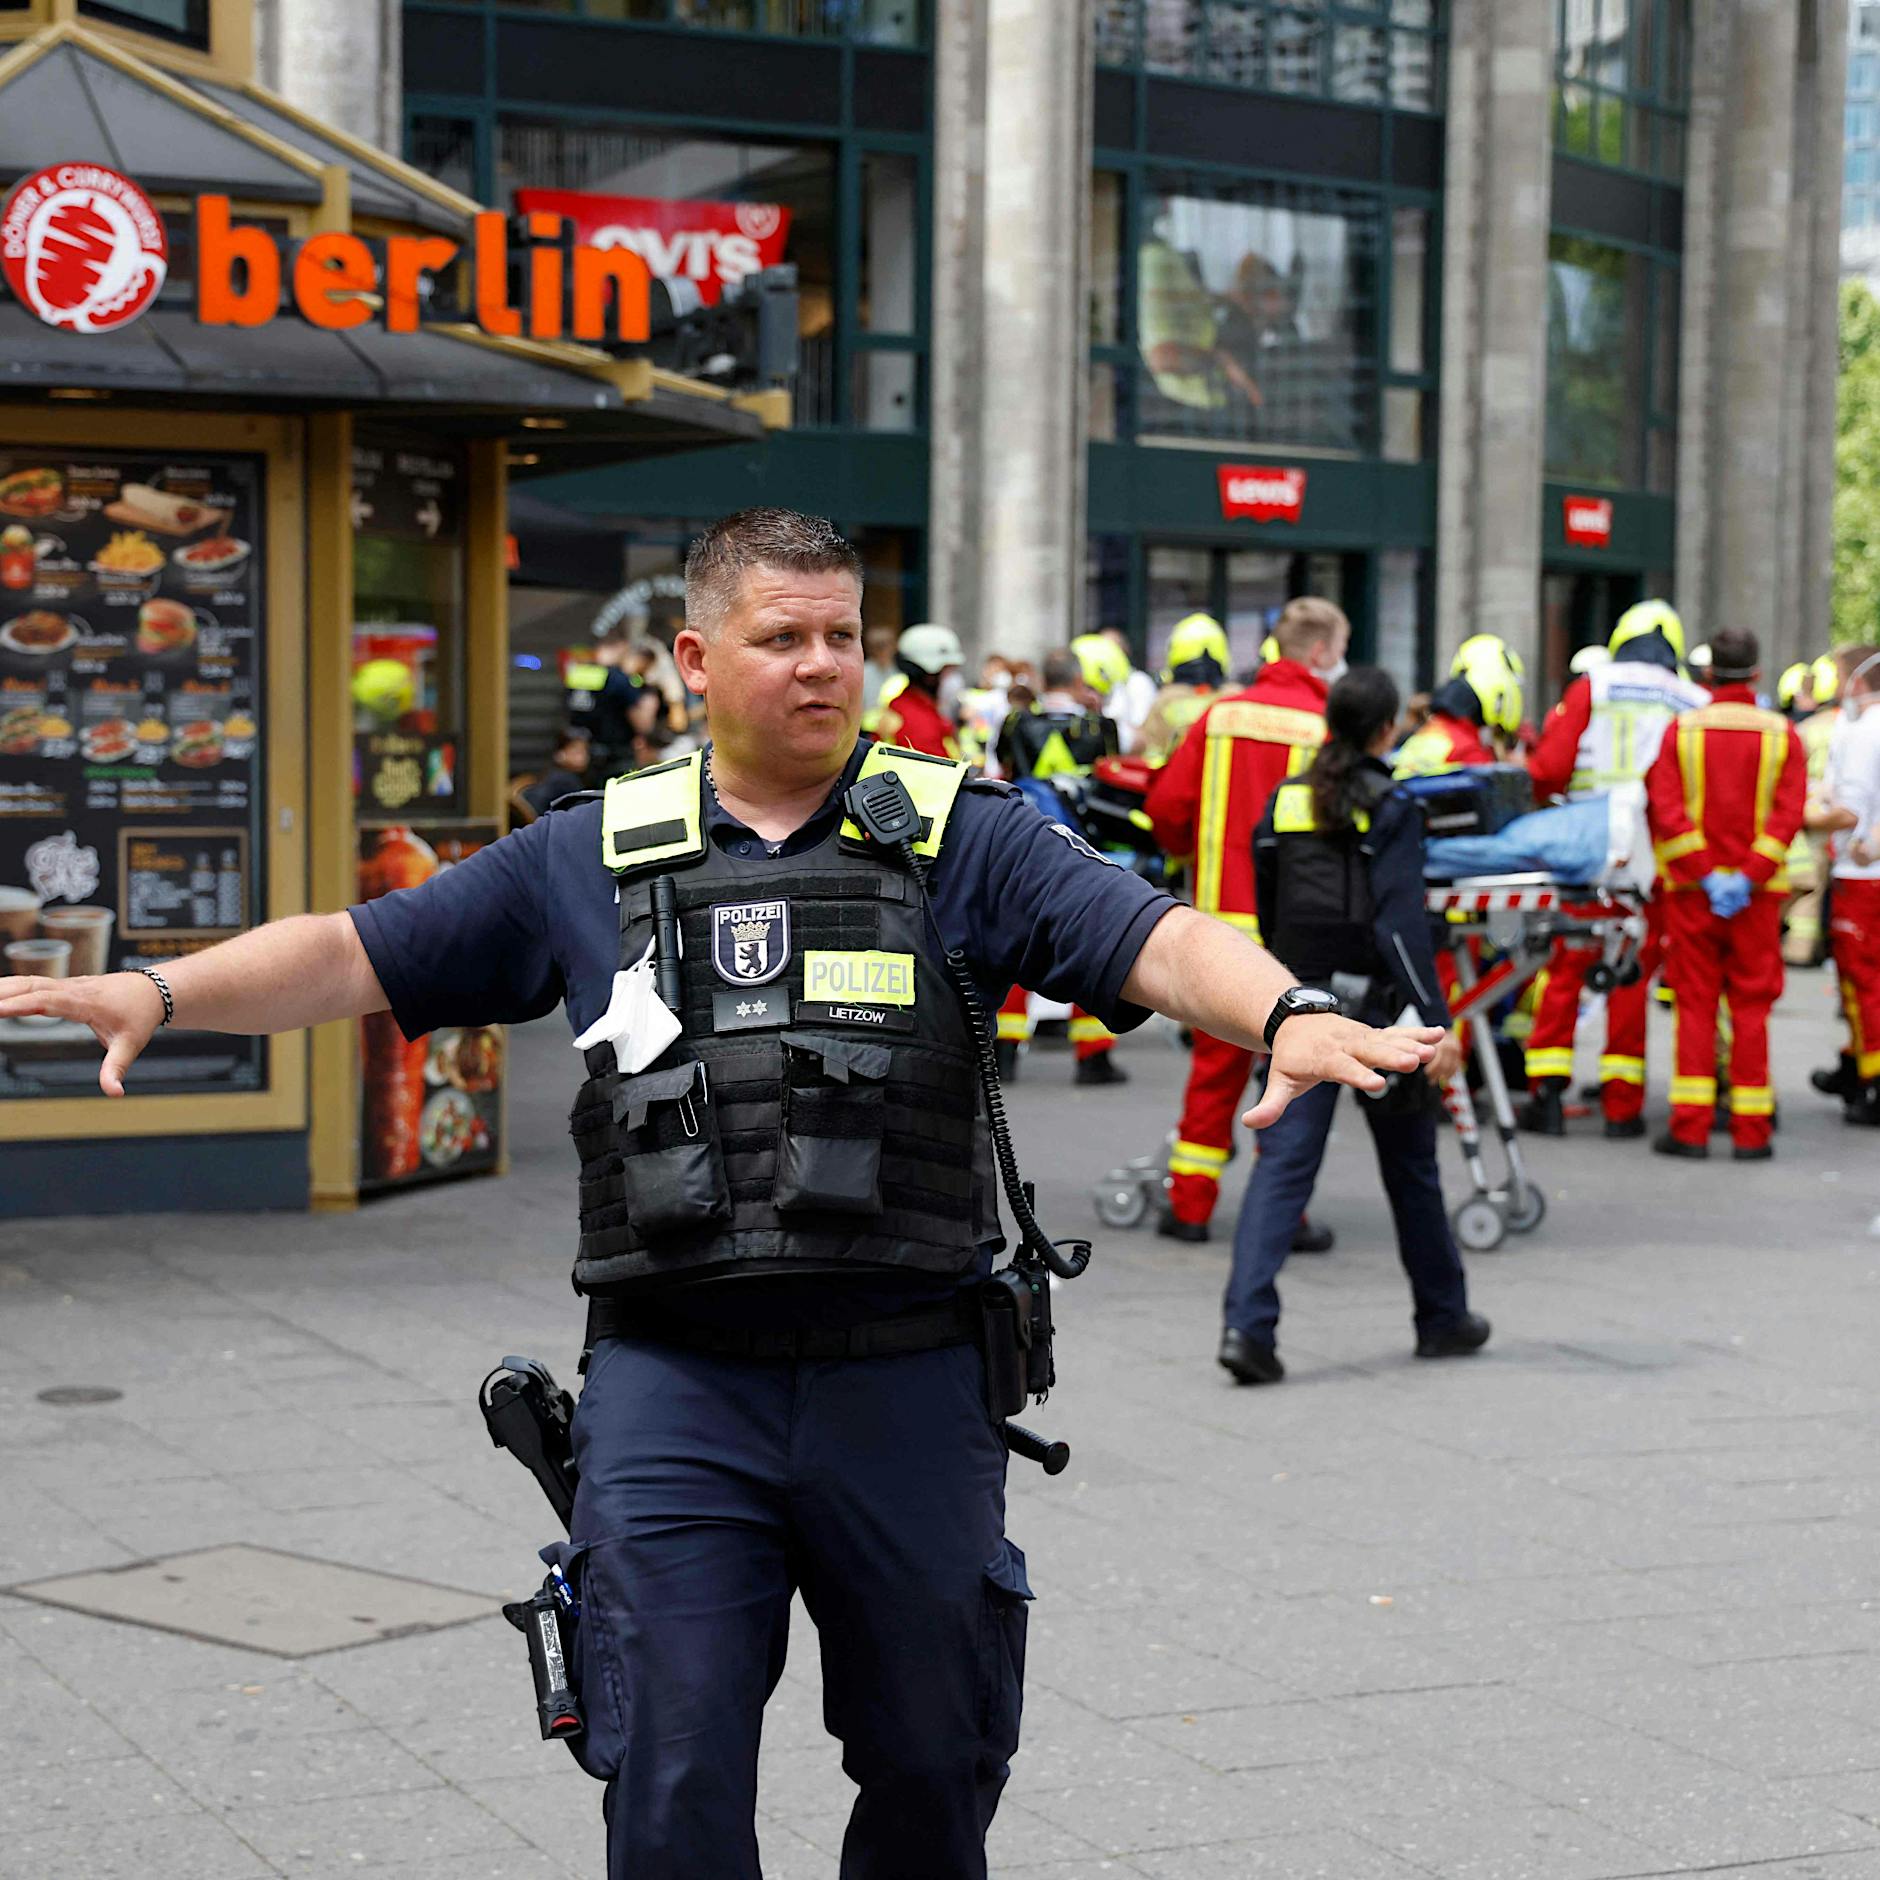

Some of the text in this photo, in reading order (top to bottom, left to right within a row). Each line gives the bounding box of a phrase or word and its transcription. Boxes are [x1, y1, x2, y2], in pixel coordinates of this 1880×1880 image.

[37, 175, 59, 197] &
[197, 194, 651, 343] berlin
[719, 904, 782, 925] POLIZEI
[811, 961, 908, 994] POLIZEI
[828, 1006, 886, 1024] LIETZOW
